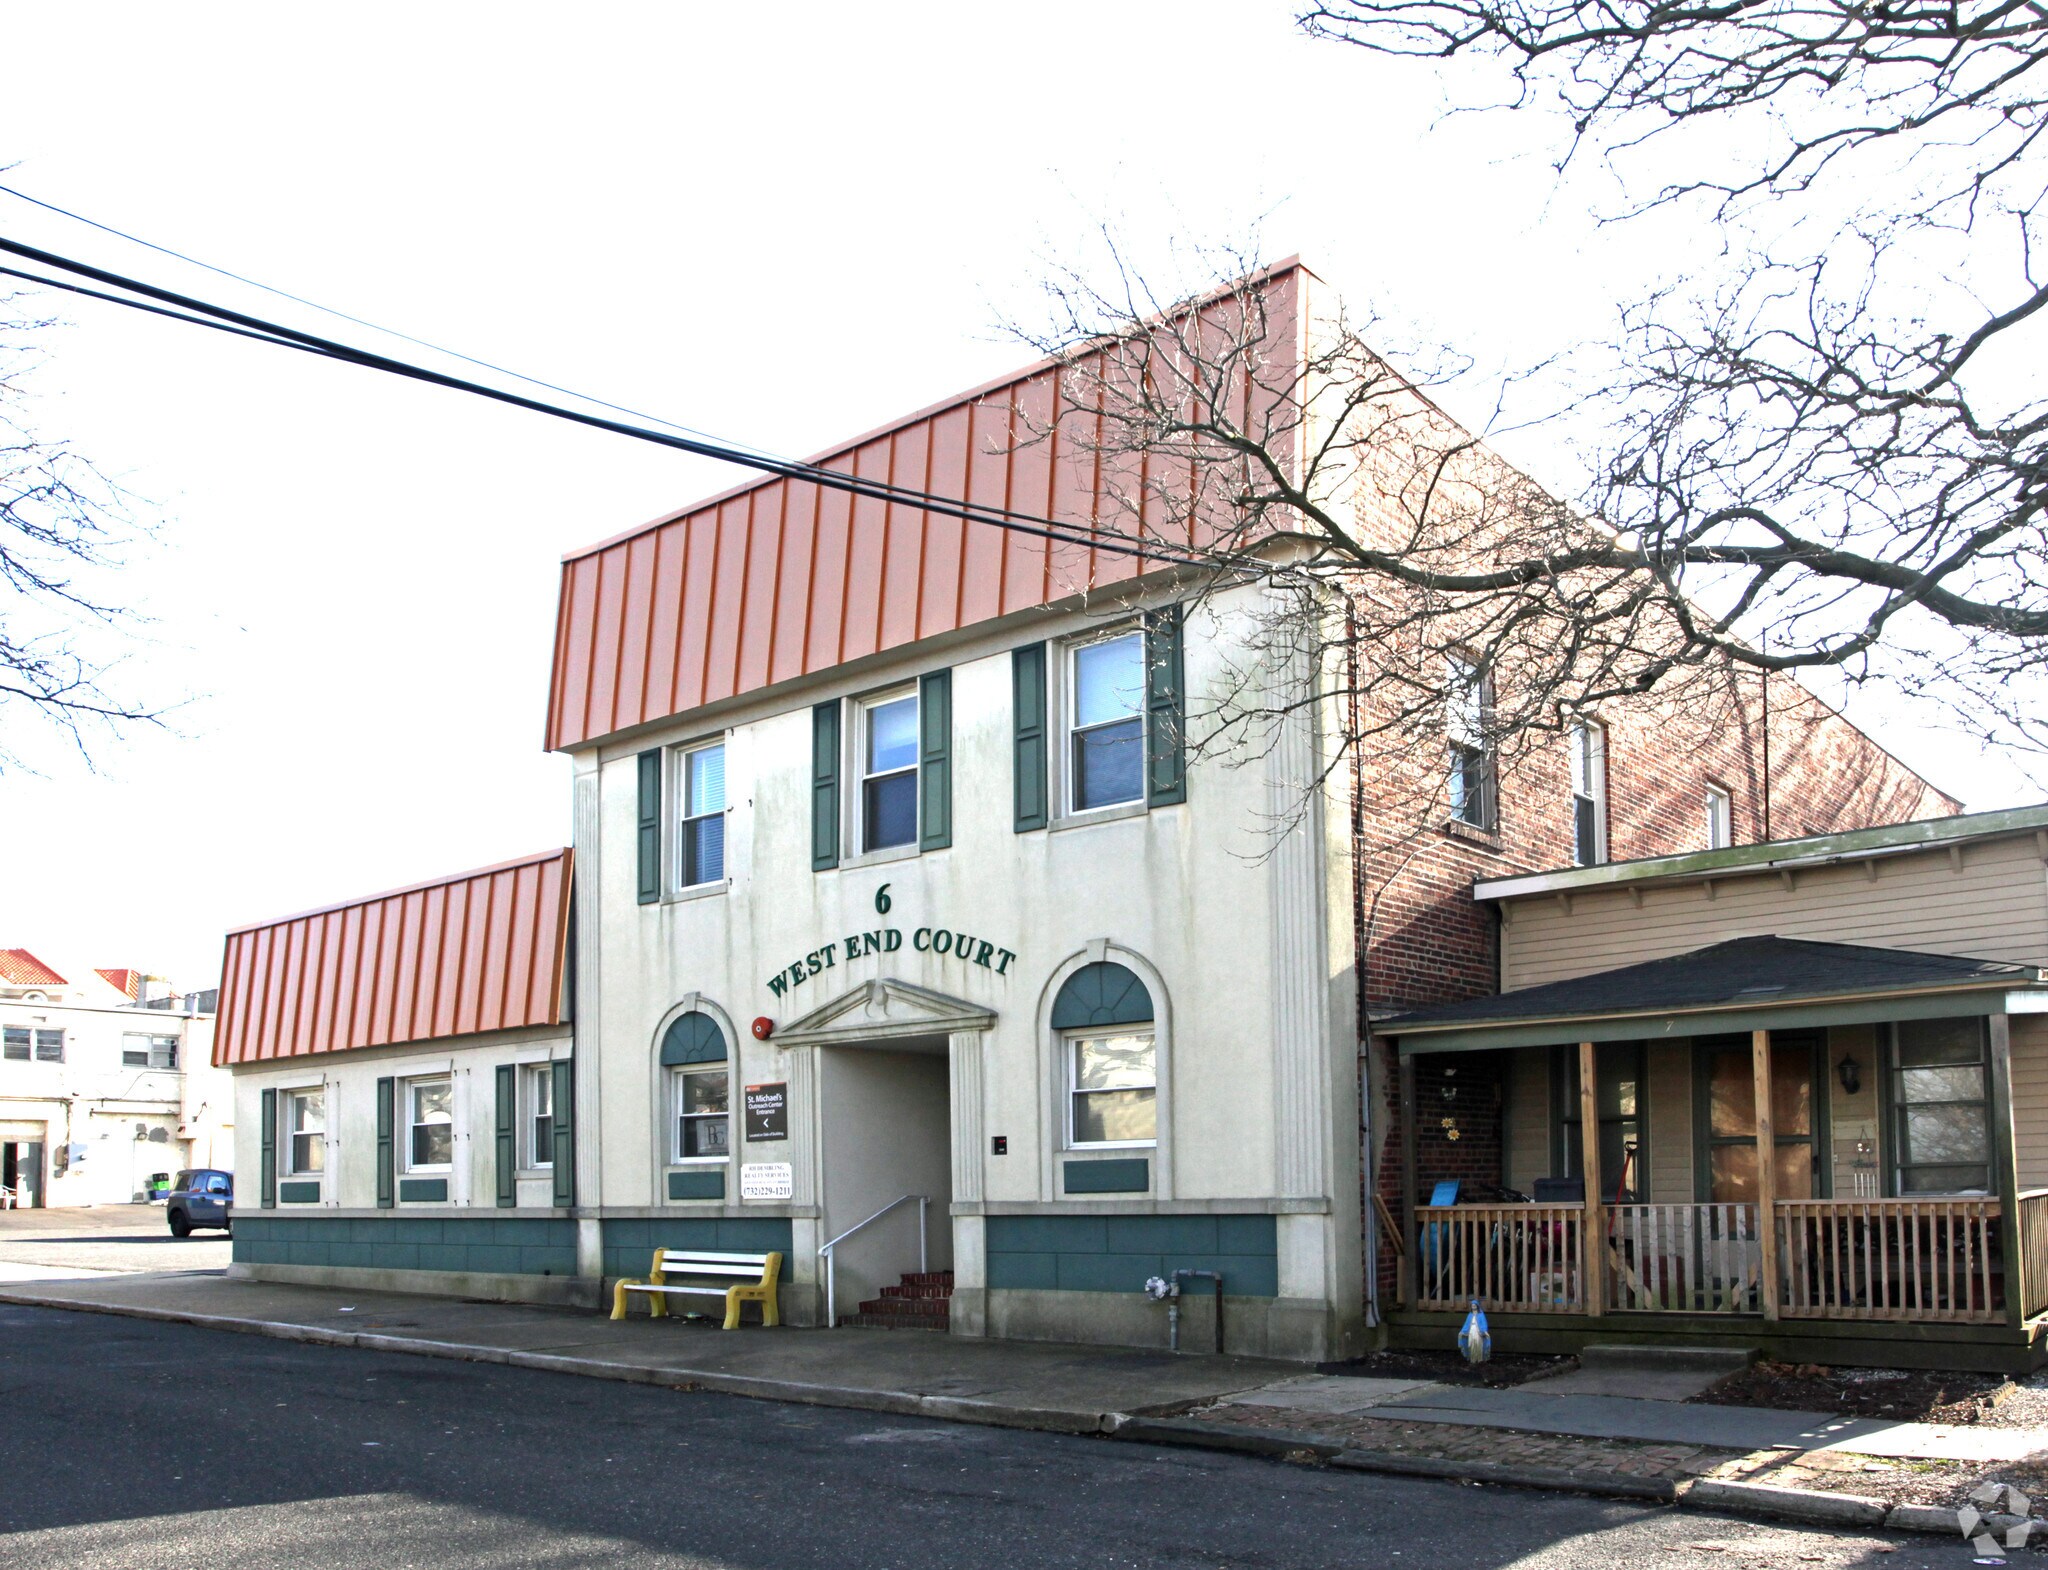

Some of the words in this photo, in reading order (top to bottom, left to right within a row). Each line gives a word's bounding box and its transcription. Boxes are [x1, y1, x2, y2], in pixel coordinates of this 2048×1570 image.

[875, 884, 891, 913] 6
[766, 943, 837, 998] WEST
[844, 929, 902, 960] END
[913, 928, 1016, 975] COURT
[747, 1095, 755, 1103] St.
[755, 1093, 782, 1102] Michael's
